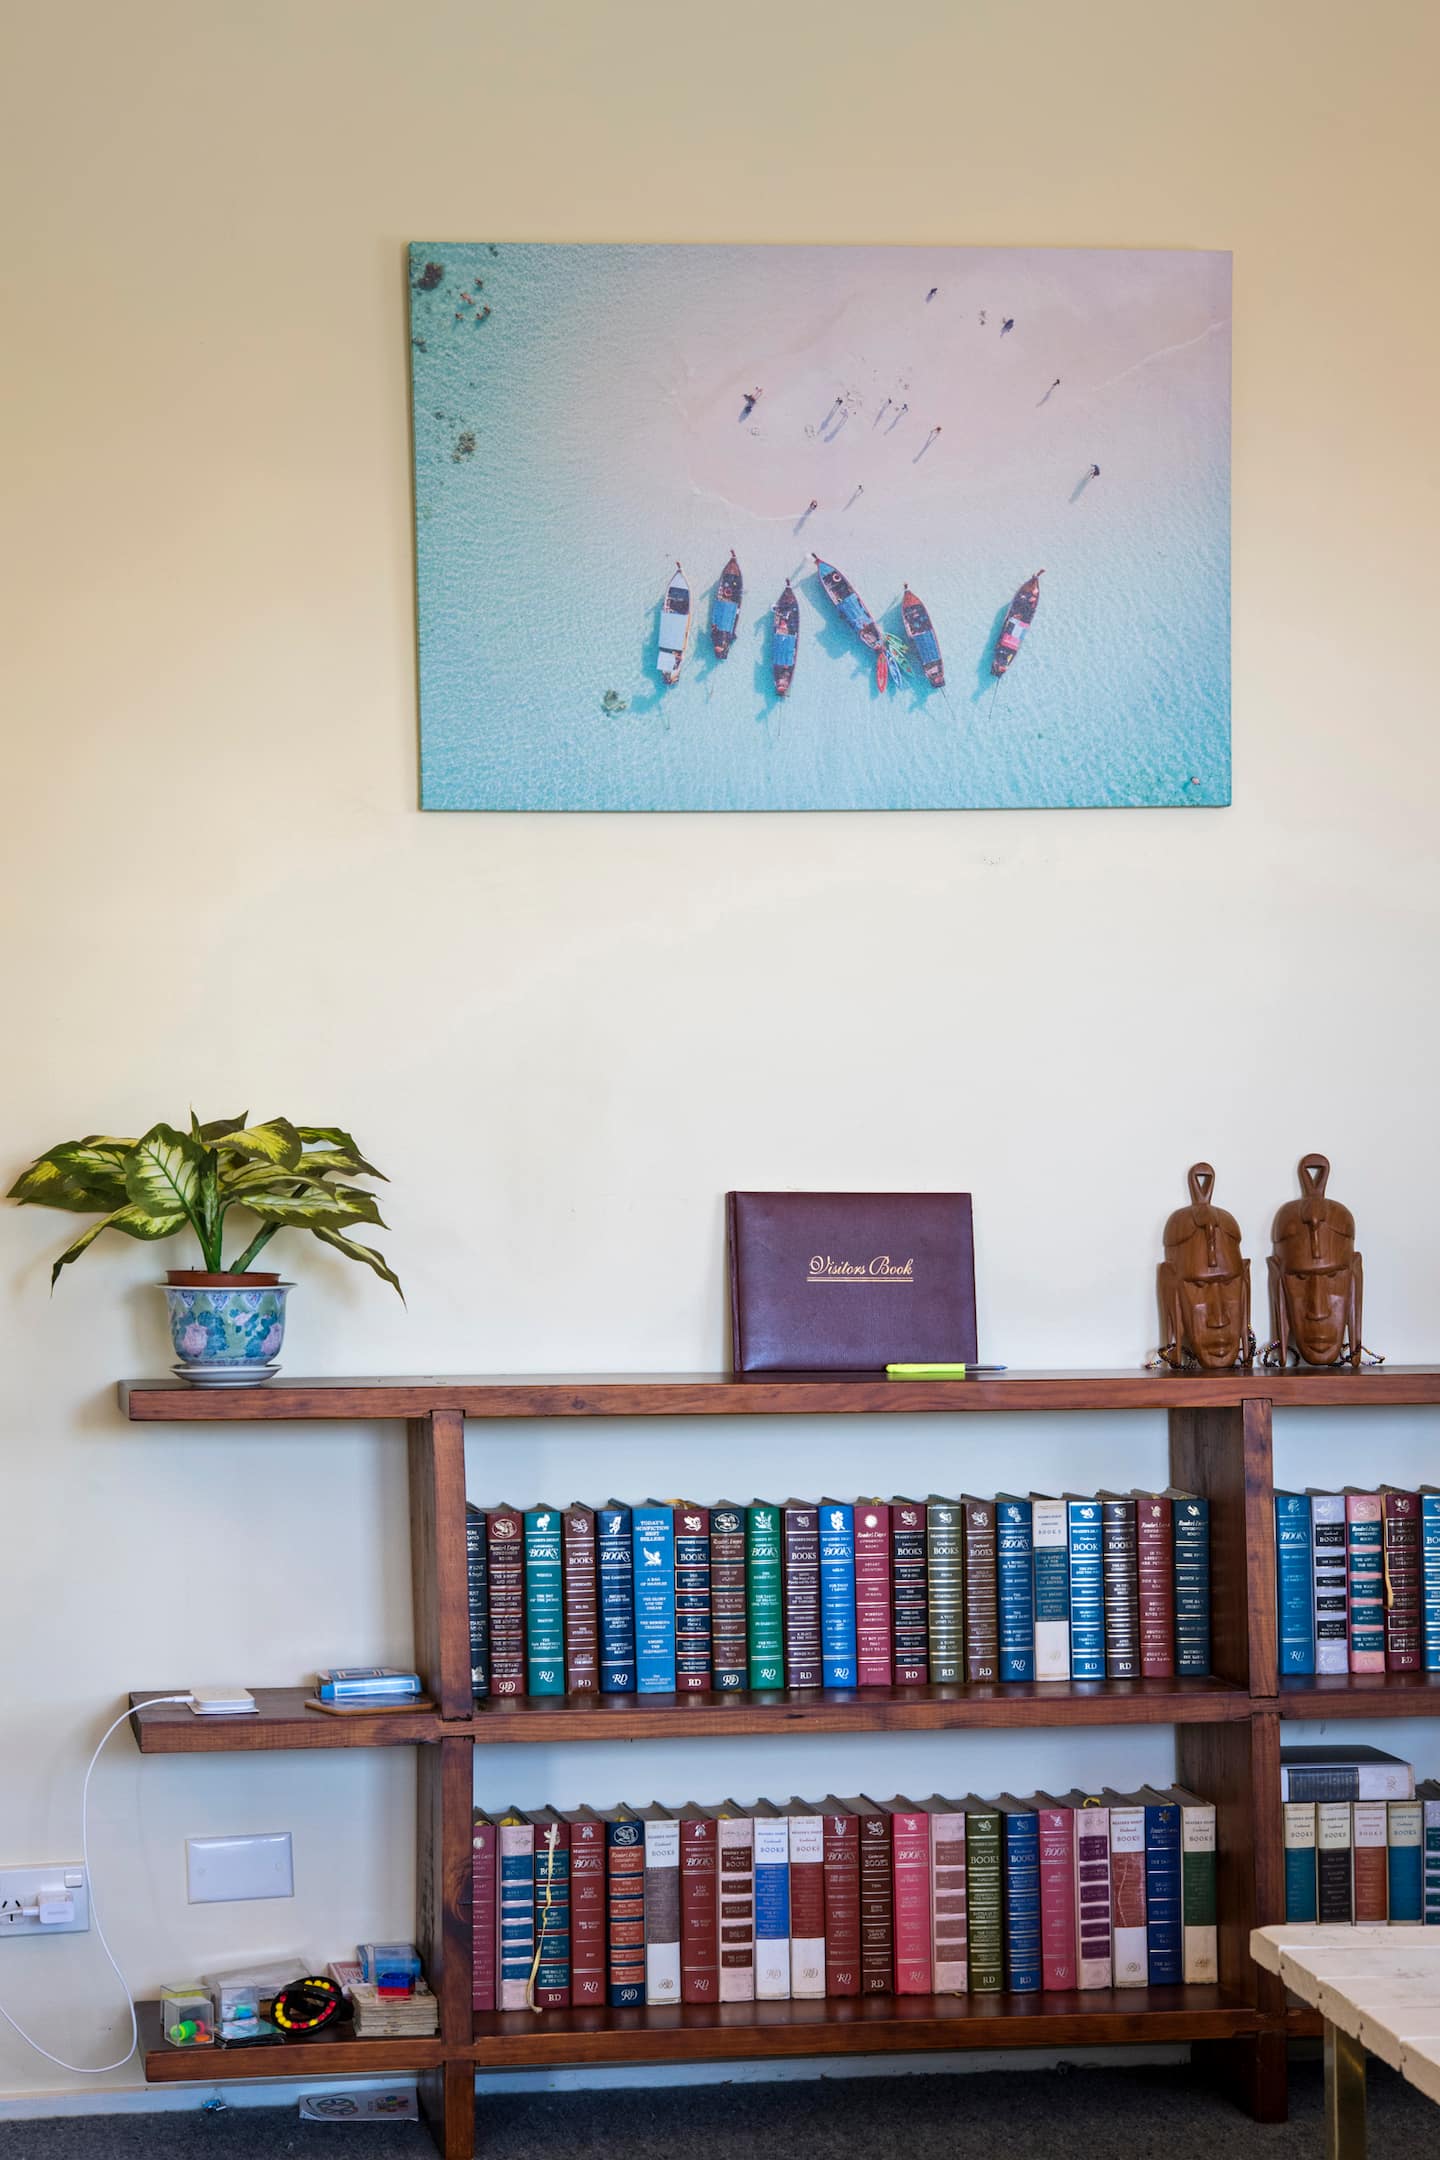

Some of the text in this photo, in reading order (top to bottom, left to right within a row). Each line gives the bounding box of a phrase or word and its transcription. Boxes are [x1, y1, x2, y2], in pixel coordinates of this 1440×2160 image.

[809, 1255, 914, 1275] Visitors Book
[1000, 1539, 1030, 1550] BOOKS
[1073, 1543, 1100, 1551] BOOK
[528, 1547, 559, 1559] BOOKS
[823, 1546, 852, 1557] BOOKS
[897, 1547, 923, 1555] BOOKS
[933, 1546, 960, 1555] BOOKS
[601, 1551, 631, 1562] BOOKS
[680, 1552, 706, 1561] BOOKS
[792, 1552, 817, 1560] BOOKS
[569, 1557, 594, 1565] BOOKS
[1011, 1659, 1026, 1671] RD
[1119, 1662, 1131, 1670] RD
[539, 1670, 554, 1682] RD
[760, 1668, 776, 1680] RD
[800, 1672, 812, 1680] RD
[834, 1668, 849, 1680] RD
[905, 1671, 918, 1679] RD
[942, 1668, 954, 1676] RD
[979, 1667, 992, 1676] RD
[612, 1673, 628, 1685] RD
[578, 1680, 592, 1688] RD
[574, 1859, 602, 1869] BOOKS
[970, 1856, 999, 1864] BOOKS
[871, 1979, 884, 1988] RD
[983, 1976, 996, 1984] RD
